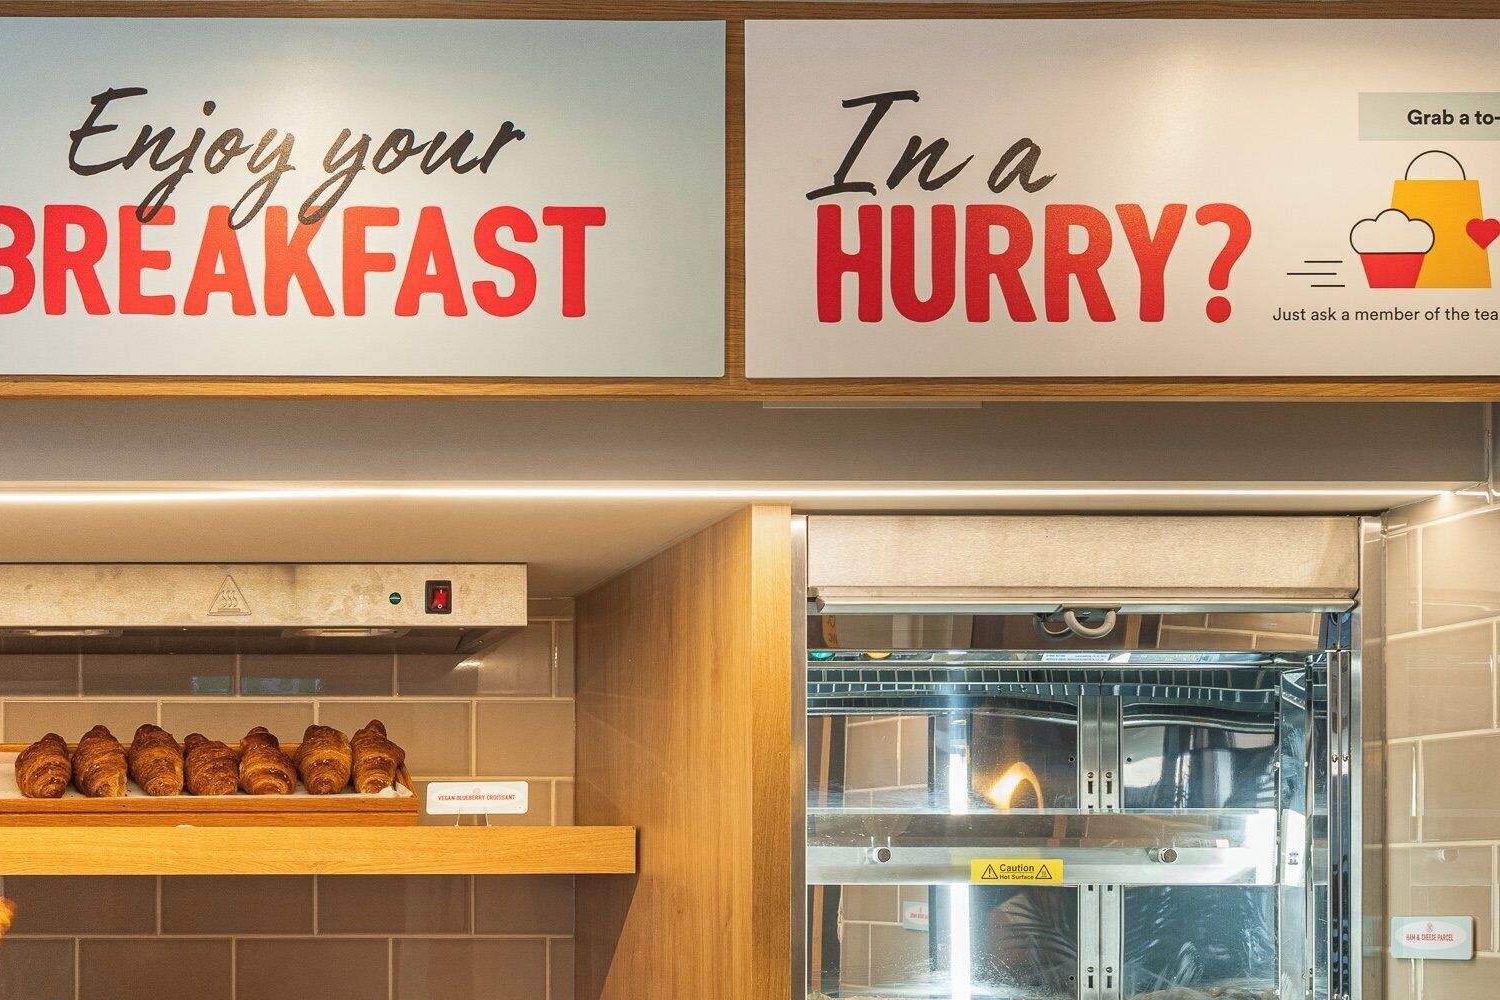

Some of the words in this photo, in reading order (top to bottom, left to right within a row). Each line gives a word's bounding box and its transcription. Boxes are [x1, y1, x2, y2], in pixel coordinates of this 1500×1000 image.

[1407, 108, 1455, 126] Grab
[1459, 112, 1470, 126] a
[805, 89, 975, 201] In
[986, 137, 1058, 194] a
[68, 86, 296, 231] Enjoy
[298, 120, 526, 226] your
[816, 202, 1253, 324] HURRY?
[1272, 307, 1306, 322] Just
[1310, 306, 1337, 322] ask
[1341, 310, 1350, 322] a
[1355, 307, 1420, 322] member
[1424, 306, 1441, 322] of
[1444, 306, 1470, 322] the
[999, 863, 1035, 872] Caution
[1437, 934, 1454, 942] PARCEL
